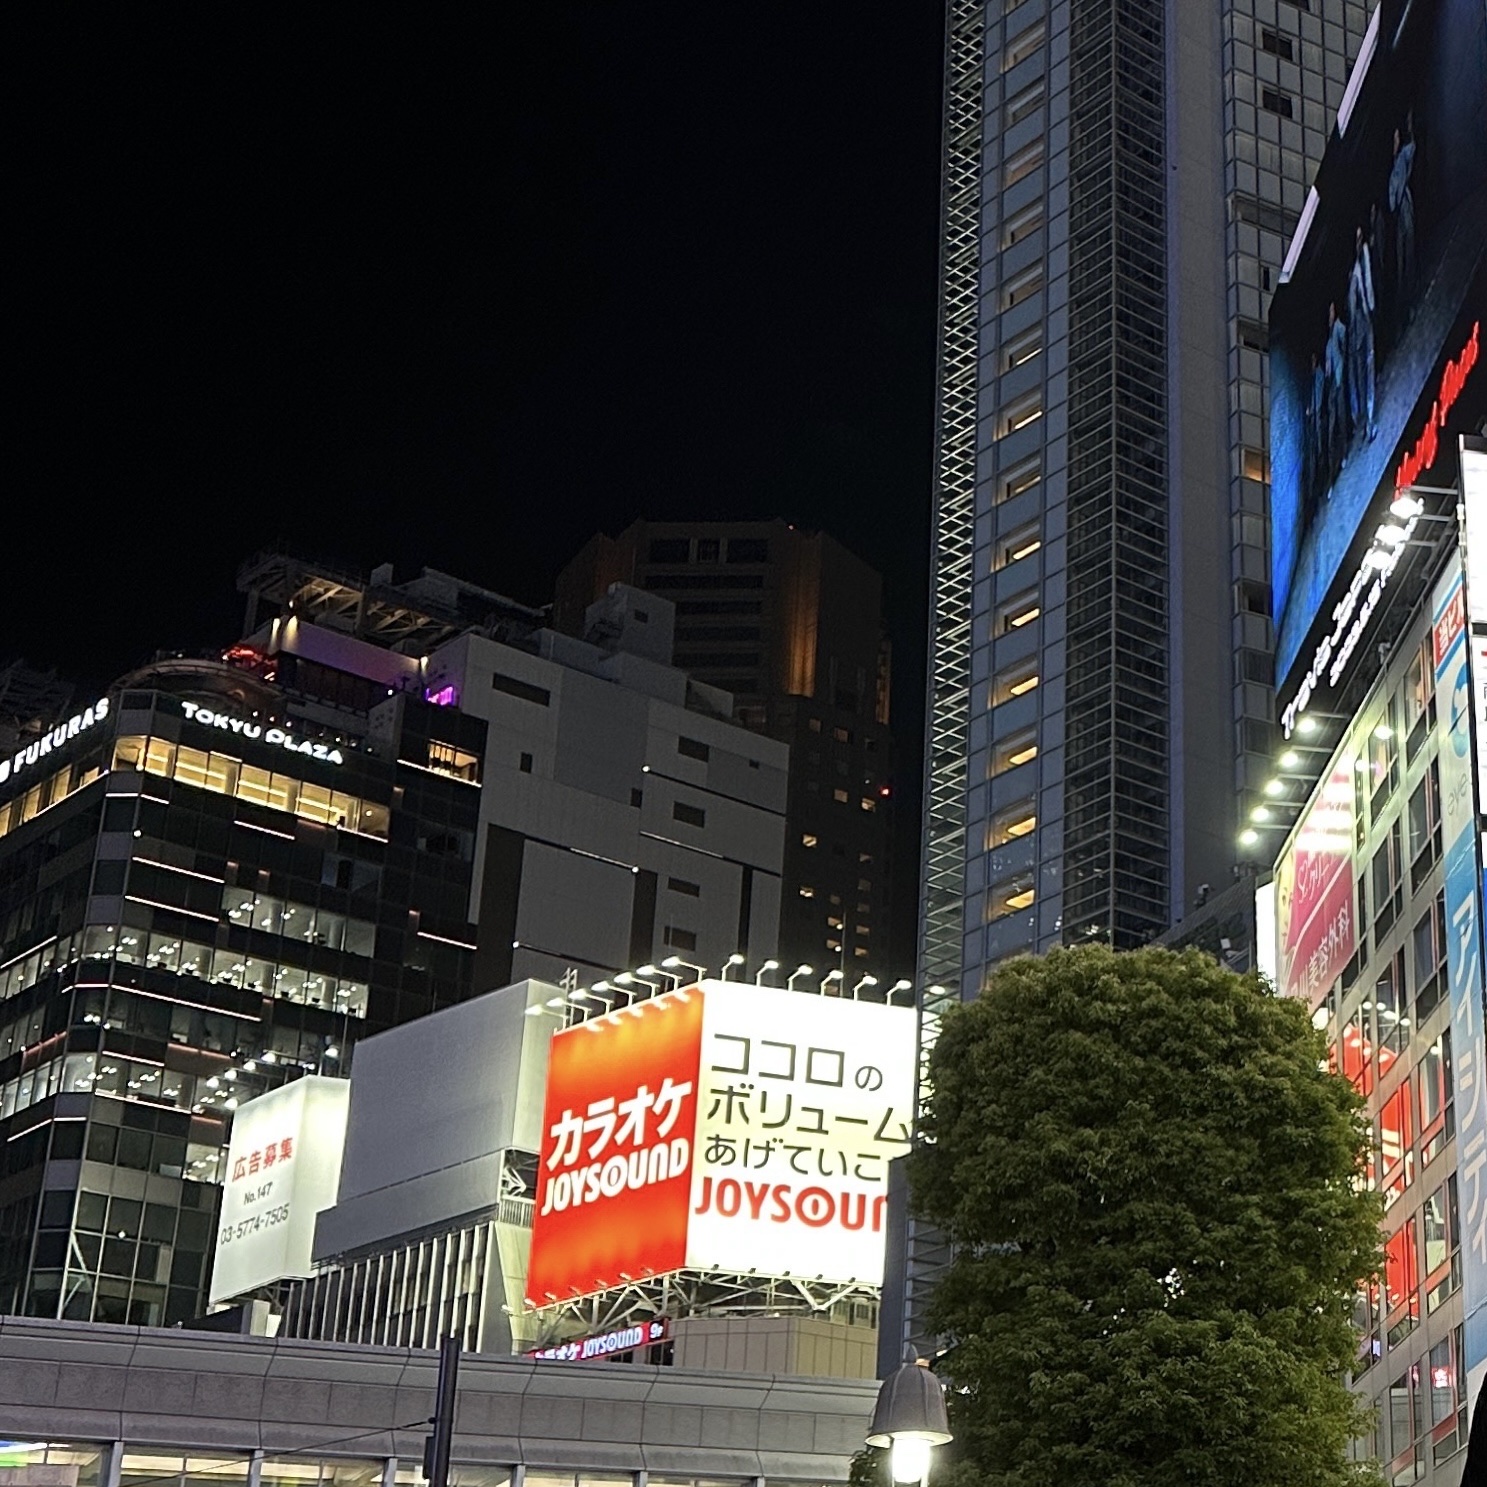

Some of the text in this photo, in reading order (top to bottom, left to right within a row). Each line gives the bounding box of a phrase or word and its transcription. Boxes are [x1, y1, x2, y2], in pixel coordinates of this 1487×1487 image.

[13, 697, 109, 773] FUKURAS
[181, 701, 344, 765] TOKYU PLAZA
[710, 1033, 884, 1092] ココロの
[546, 1078, 693, 1171] カラオケ
[706, 1083, 914, 1144] ボリューム
[232, 1137, 293, 1183] 広告募集
[540, 1138, 690, 1217] JOYSOUND
[704, 1134, 882, 1182] あげていこ
[581, 1326, 643, 1359] JOYSOUND
